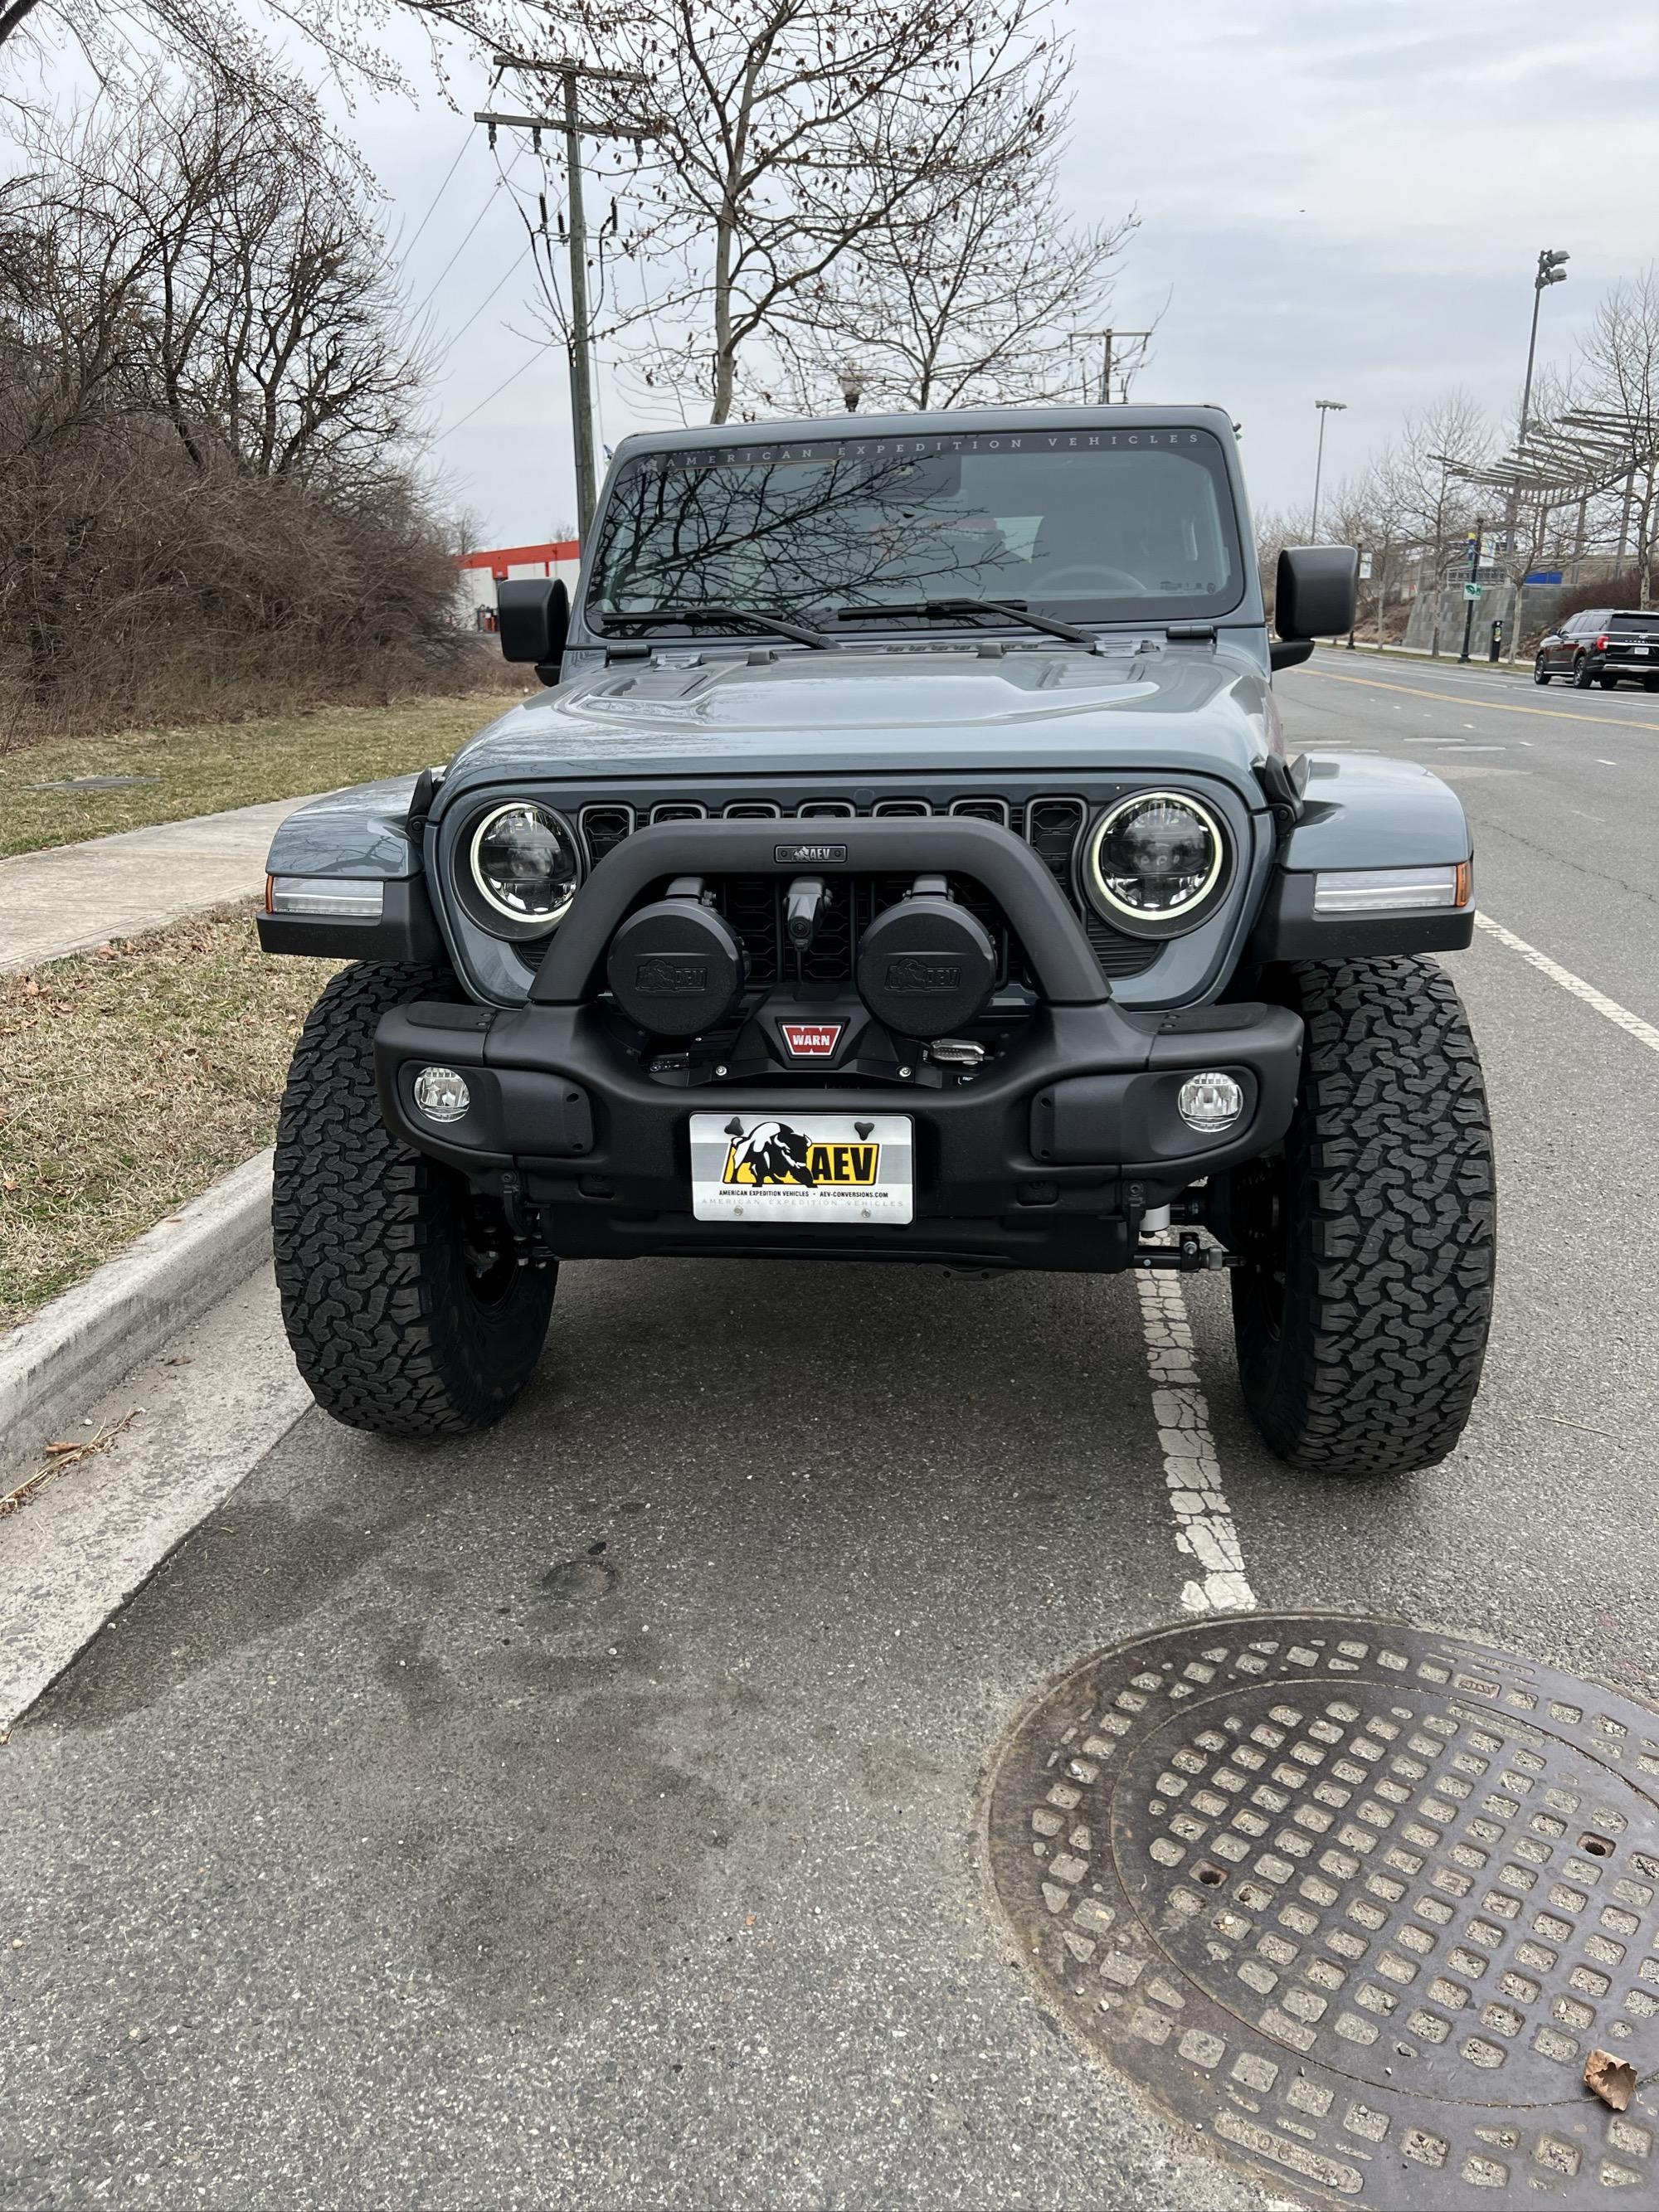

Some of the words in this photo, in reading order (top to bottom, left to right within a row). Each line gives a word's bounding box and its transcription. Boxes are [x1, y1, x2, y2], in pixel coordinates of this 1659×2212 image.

[666, 449, 812, 467] AMERICAN
[838, 439, 1022, 456] EXPEDITION
[1048, 434, 1198, 446] VEHICLES
[810, 848, 830, 860] AEV
[792, 1034, 830, 1046] WARN
[811, 1147, 873, 1181] AEV
[769, 1198, 838, 1207] EXPEDITION
